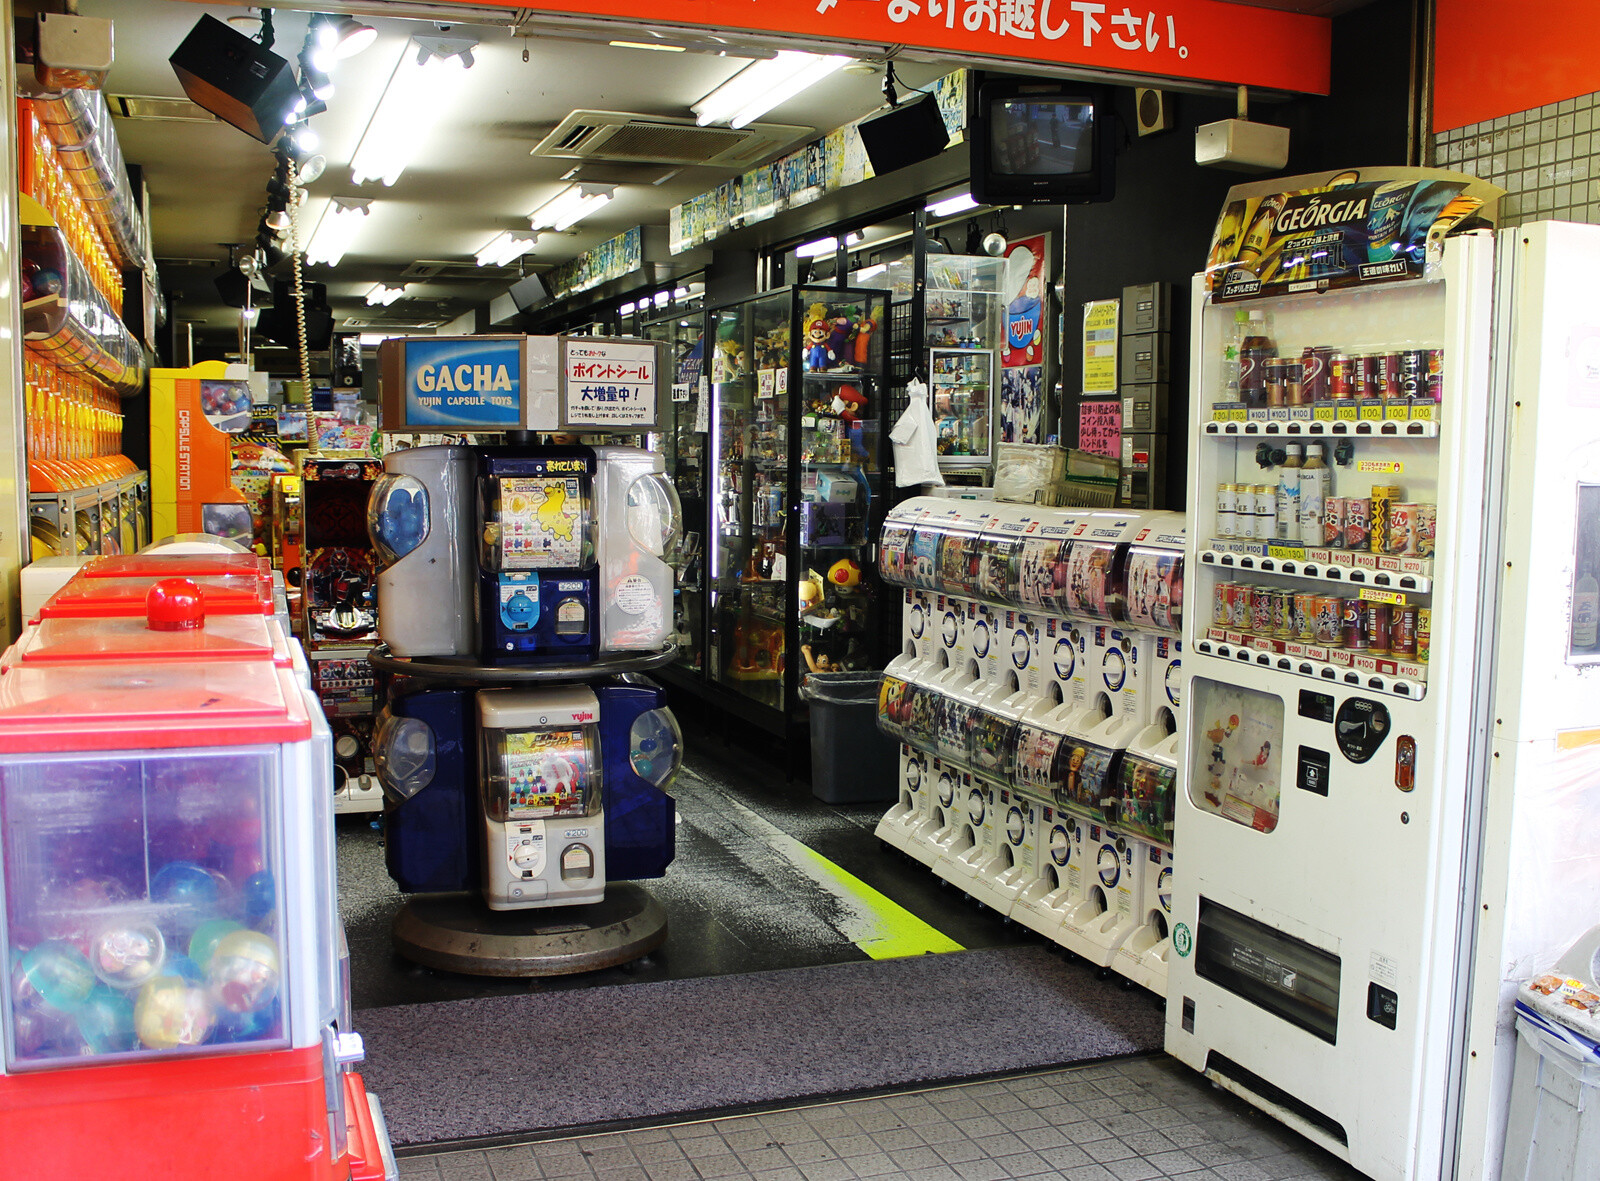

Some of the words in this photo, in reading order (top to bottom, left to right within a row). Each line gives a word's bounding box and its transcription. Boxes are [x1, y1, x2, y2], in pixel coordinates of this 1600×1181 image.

[816, 0, 1189, 59] よりお越し下さい。
[1010, 317, 1032, 340] YUJIN
[416, 364, 512, 392] GACHA
[573, 362, 650, 380] ポイントシール
[1404, 353, 1418, 399] BLACK
[418, 396, 442, 408] YUJIN
[447, 396, 485, 406] CAPSULE
[491, 396, 512, 406] TOYS
[179, 410, 190, 453] CAPSULE
[180, 453, 191, 491] STATION
